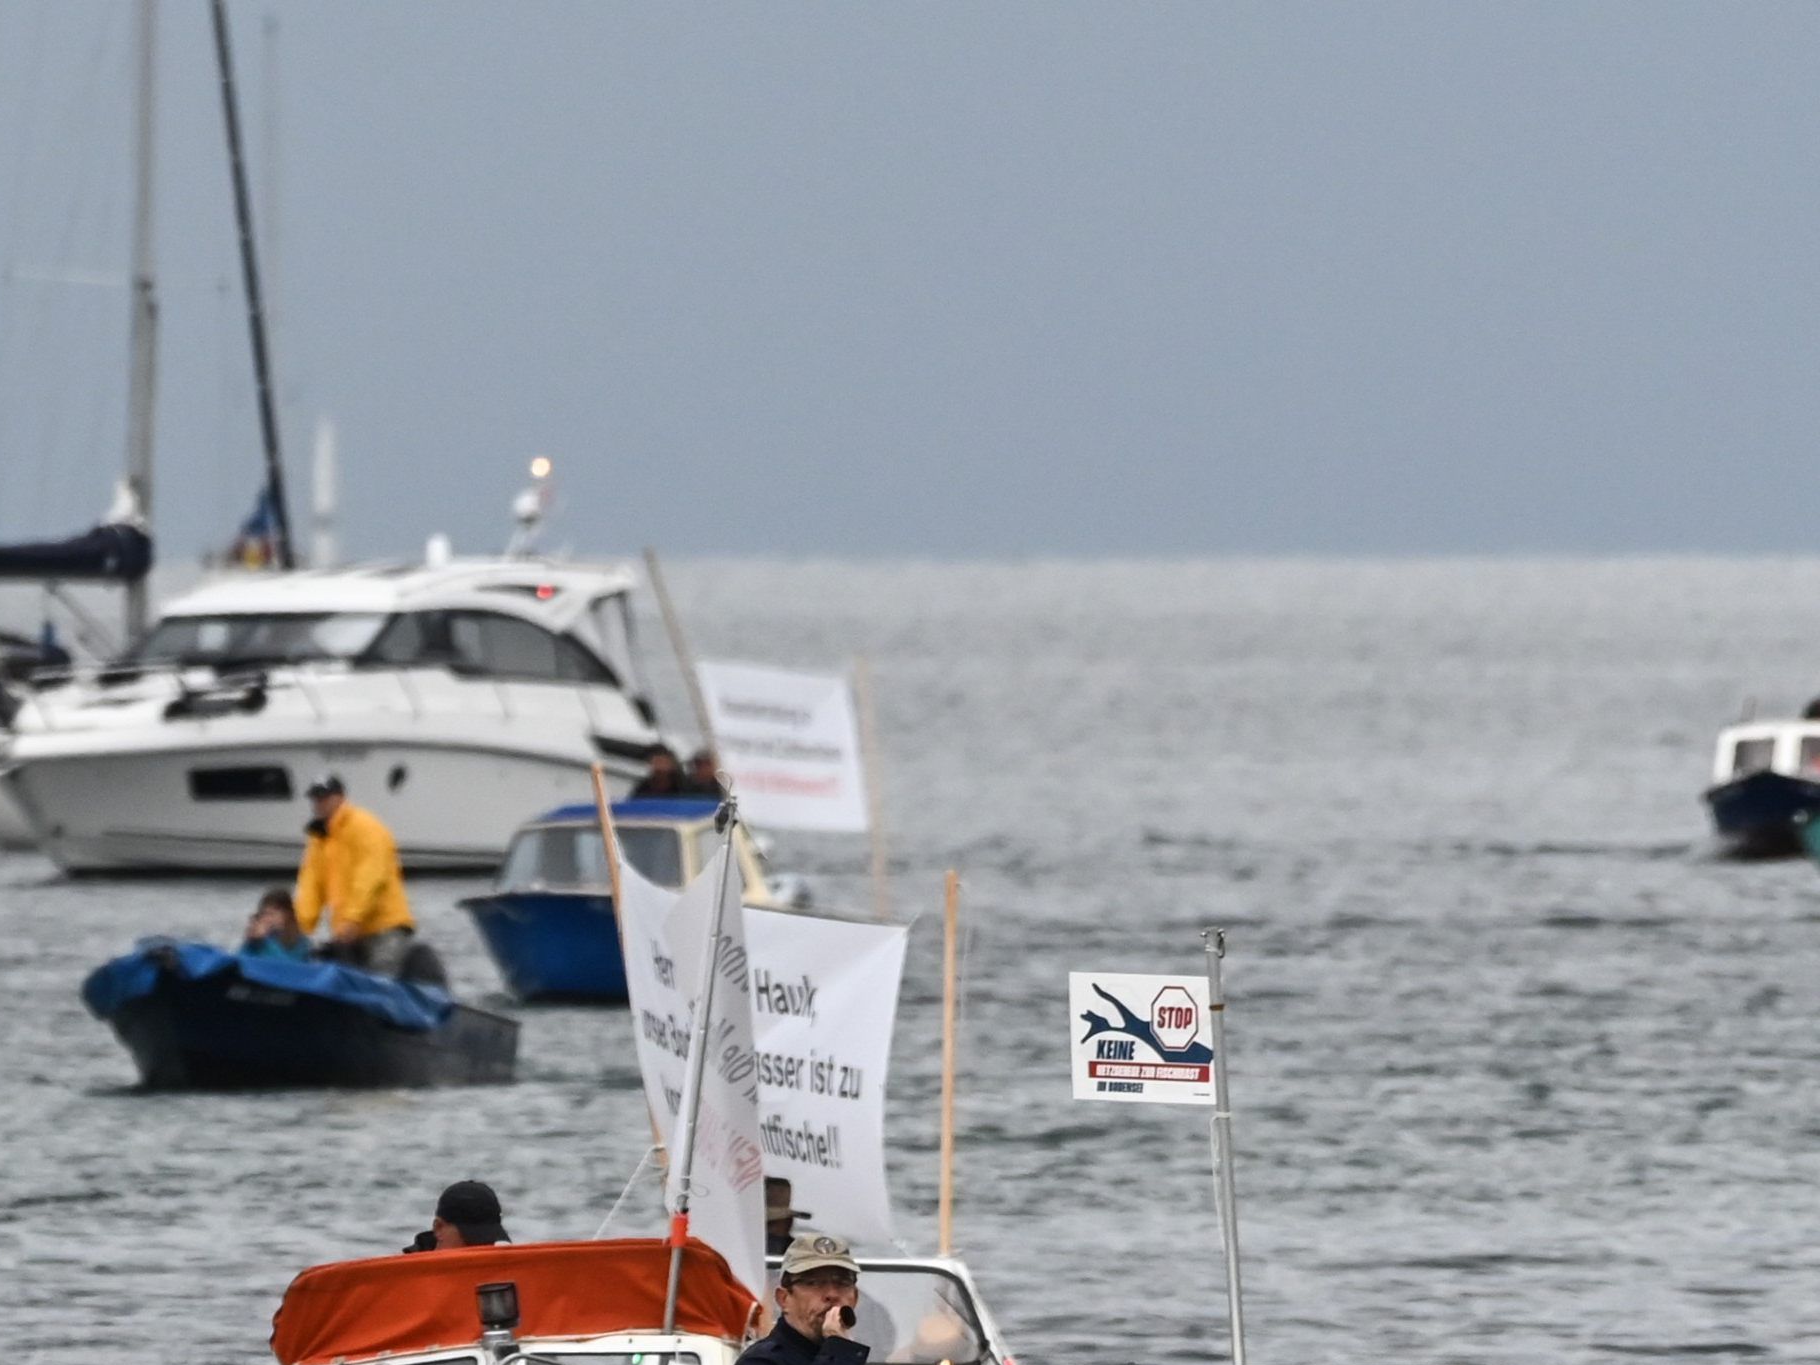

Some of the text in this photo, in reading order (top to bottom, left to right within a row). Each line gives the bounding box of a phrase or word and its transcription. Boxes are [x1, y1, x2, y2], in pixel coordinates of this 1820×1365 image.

[754, 969, 817, 1028] Hauk,
[1158, 1006, 1193, 1029] STOP
[1097, 1040, 1135, 1060] KEINE
[810, 1048, 834, 1096] ist
[839, 1065, 862, 1100] zu
